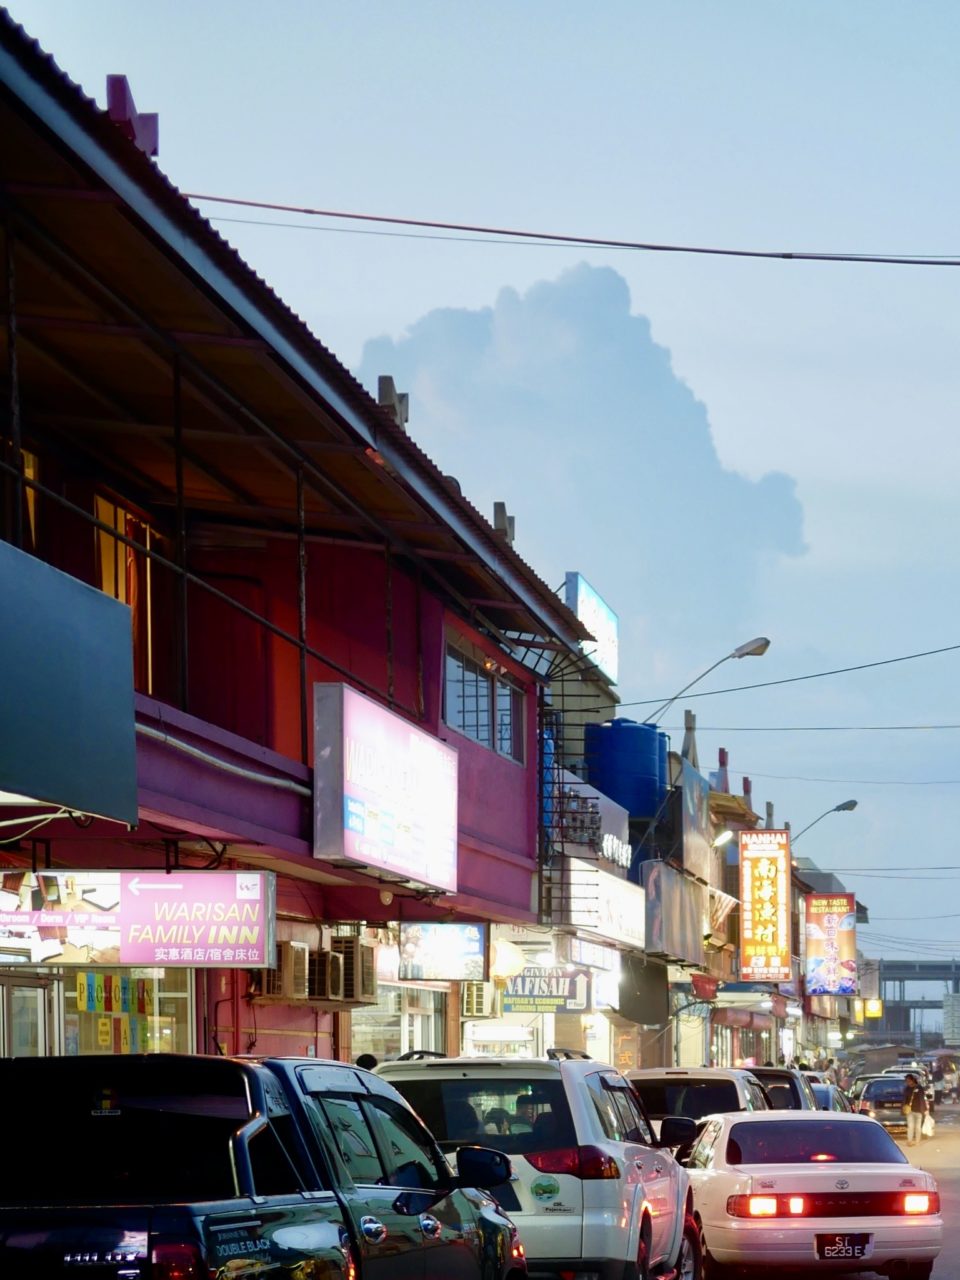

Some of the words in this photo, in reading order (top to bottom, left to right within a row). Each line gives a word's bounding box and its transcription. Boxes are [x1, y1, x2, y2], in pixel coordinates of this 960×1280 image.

[742, 834, 787, 844] NANHAI
[828, 898, 848, 906] TASTE
[154, 902, 260, 922] WARISAN
[127, 925, 205, 944] FAMILY
[207, 926, 260, 944] INN
[504, 977, 571, 996] NAFISAH
[216, 1242, 247, 1256] DOUBLE
[246, 1239, 272, 1252] BLACK
[835, 1236, 850, 1247] ST
[824, 1246, 853, 1257] 6233
[855, 1246, 863, 1257] E
